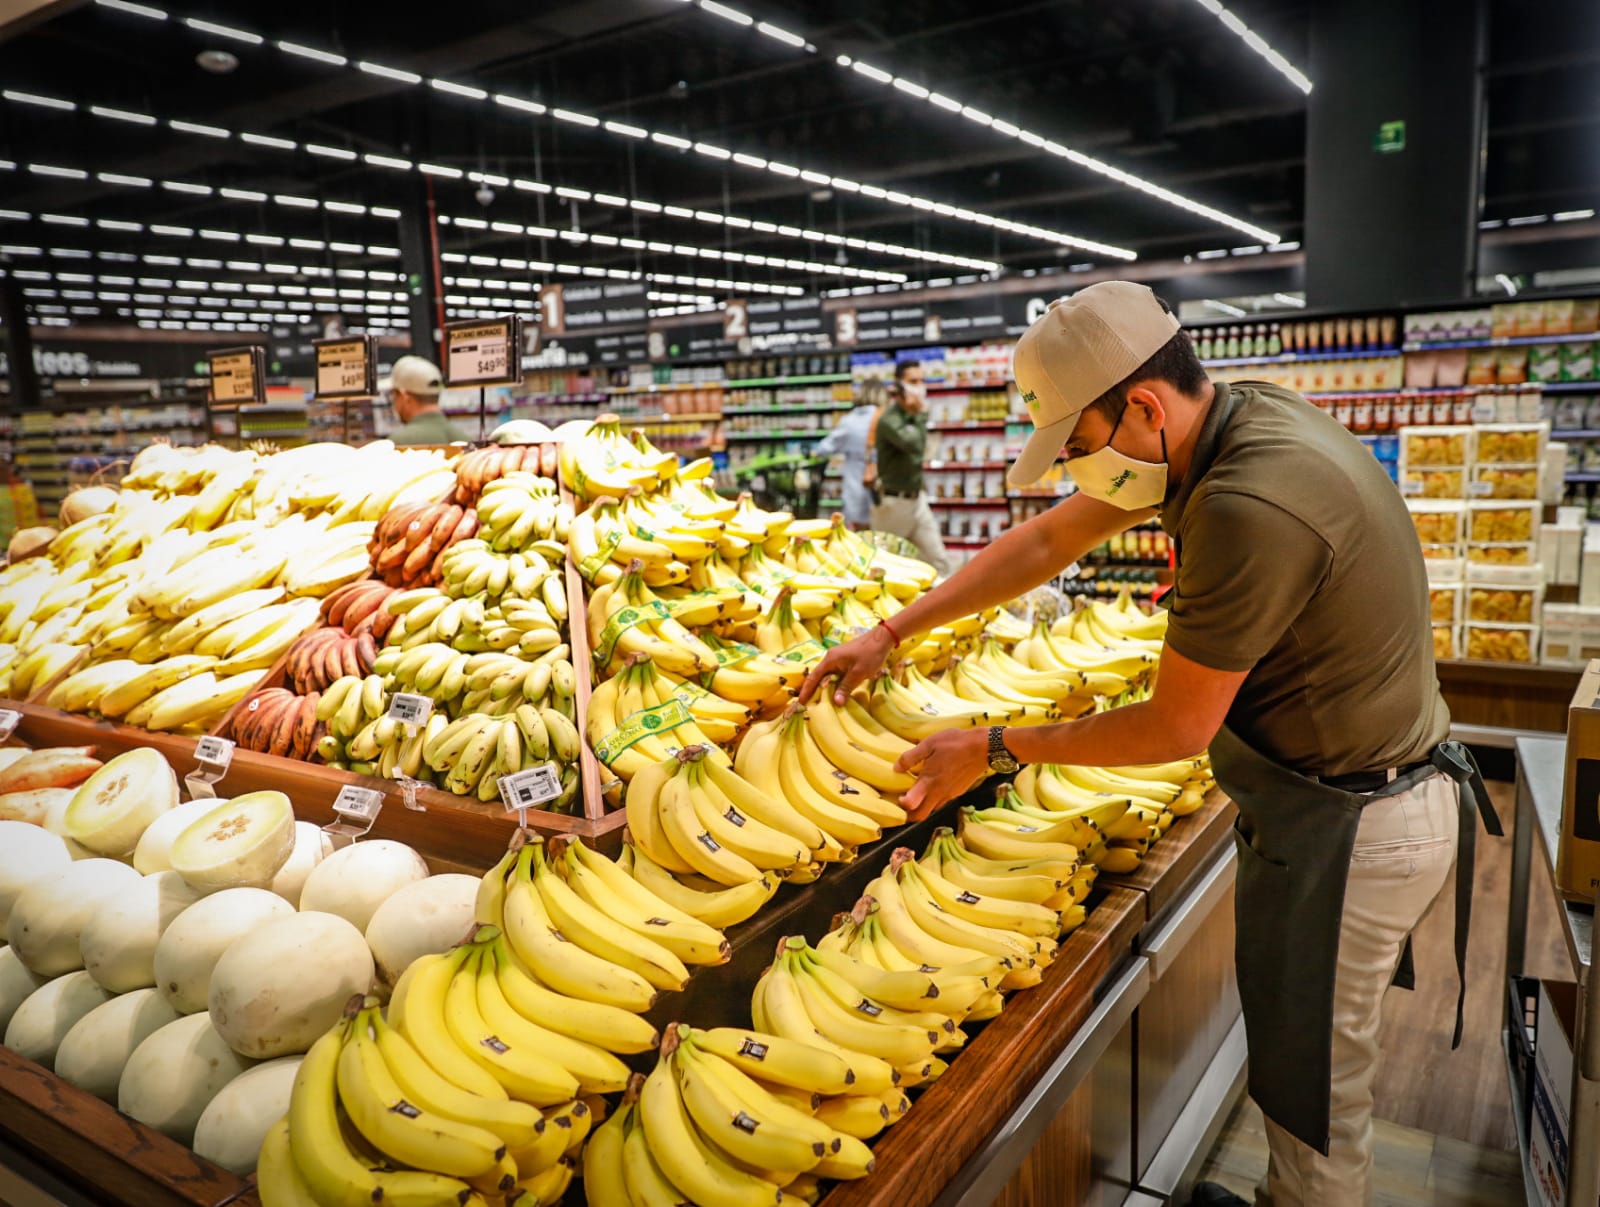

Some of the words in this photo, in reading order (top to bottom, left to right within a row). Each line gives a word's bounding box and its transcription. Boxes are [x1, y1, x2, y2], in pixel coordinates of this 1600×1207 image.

[542, 291, 558, 328] 1
[725, 305, 746, 338] 2
[523, 327, 540, 354] 7
[836, 312, 856, 342] 3
